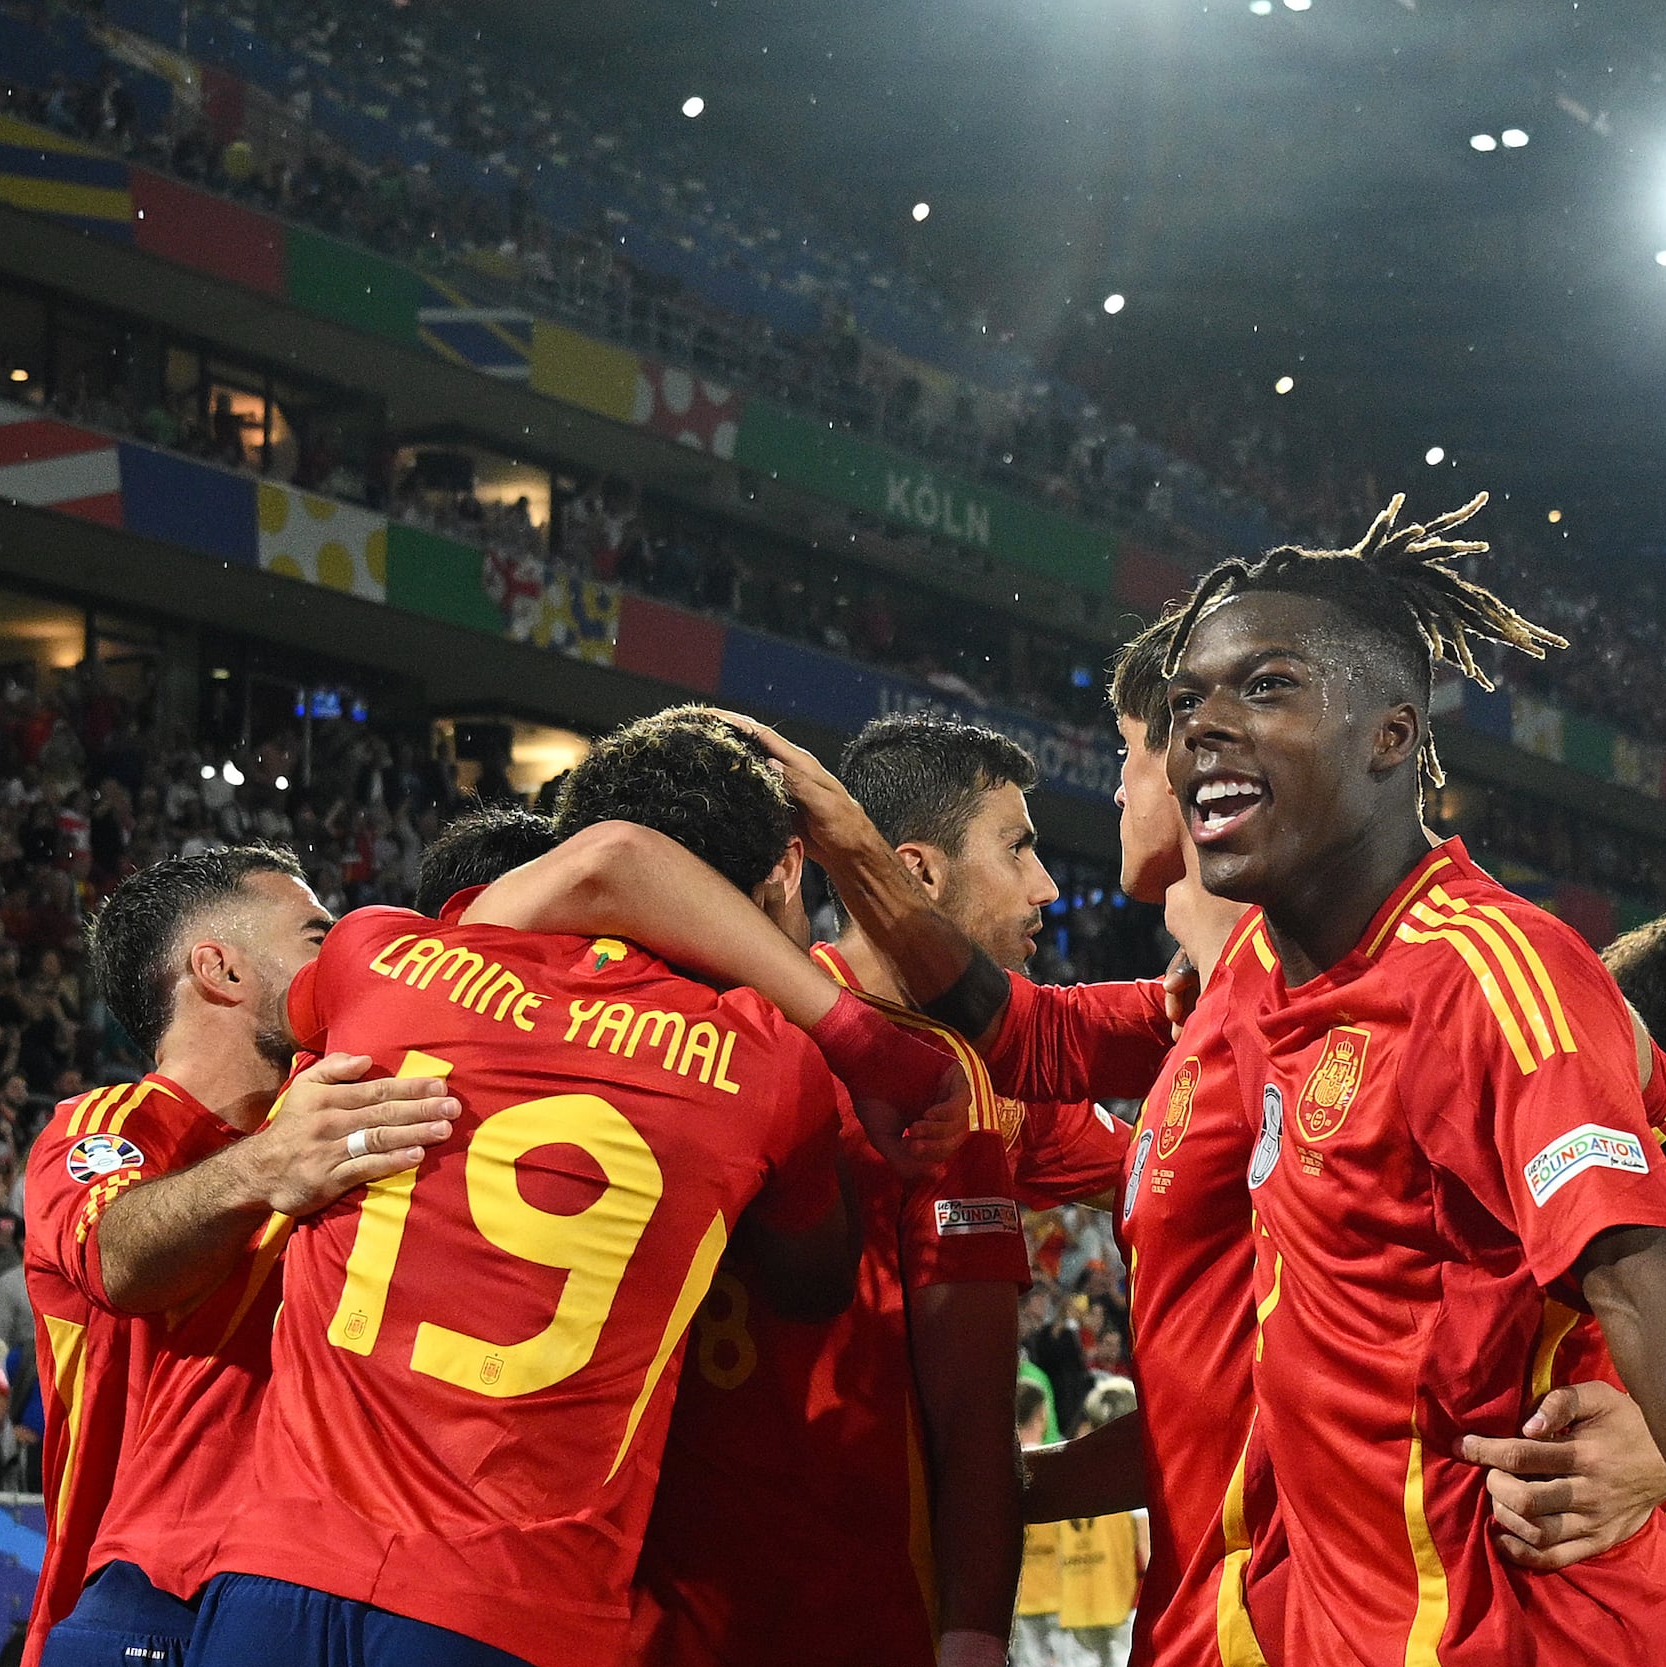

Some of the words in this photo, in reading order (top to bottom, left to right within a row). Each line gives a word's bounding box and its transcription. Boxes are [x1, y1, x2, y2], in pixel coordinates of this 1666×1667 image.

[887, 473, 989, 543] KÖLN
[369, 933, 554, 1033] LAMINE
[562, 998, 743, 1096] YAMAL
[1527, 1153, 1550, 1177] UEFA
[1531, 1137, 1643, 1192] FOUNDATION
[327, 1049, 664, 1398] 19
